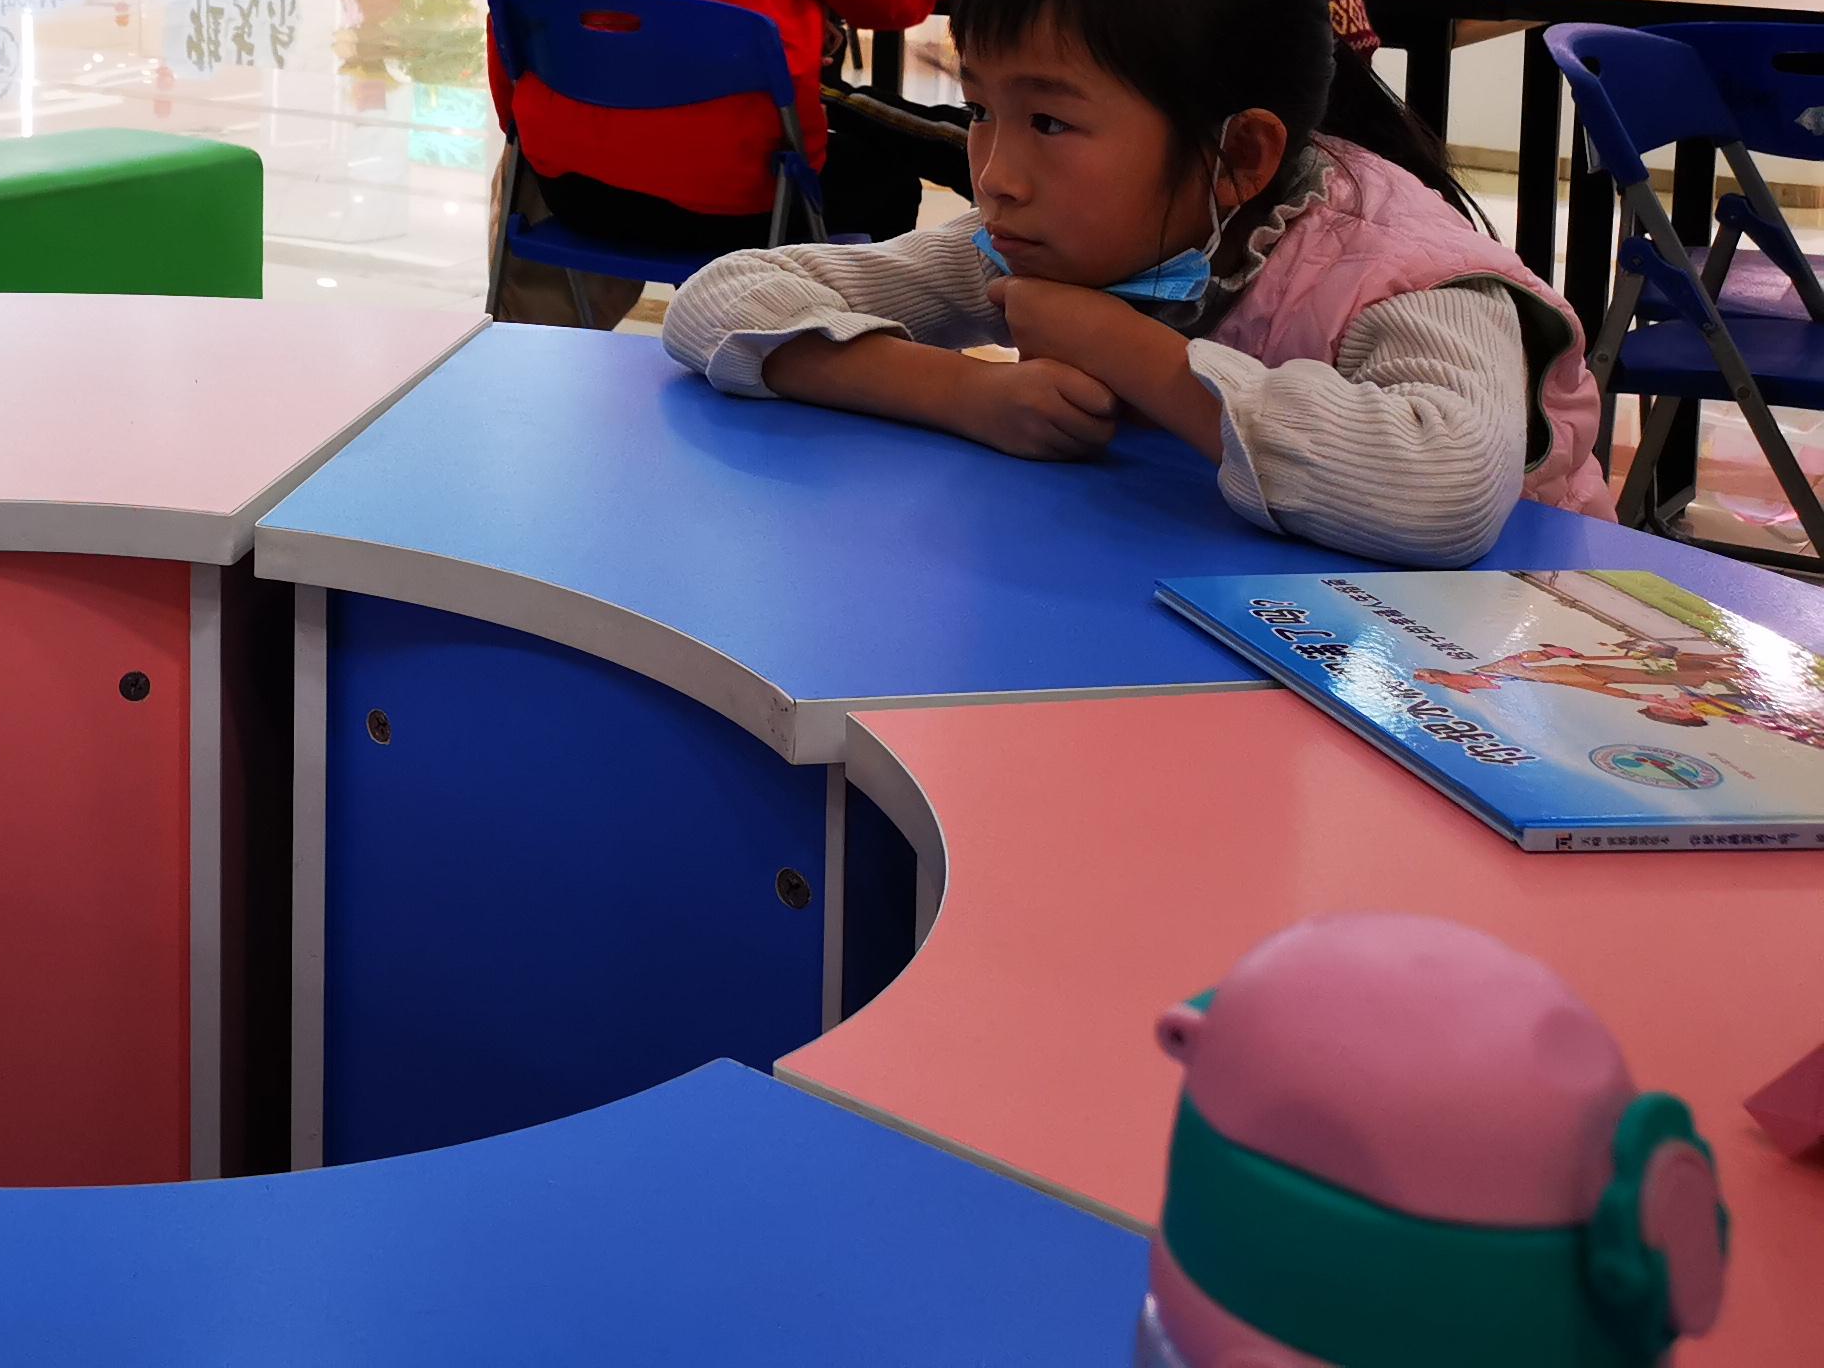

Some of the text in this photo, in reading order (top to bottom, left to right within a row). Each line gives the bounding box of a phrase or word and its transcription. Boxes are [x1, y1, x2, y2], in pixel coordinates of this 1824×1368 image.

[1320, 578, 1479, 660] 给孩子的幸福人生指南
[1249, 598, 1538, 766] 你把水满了吗？
